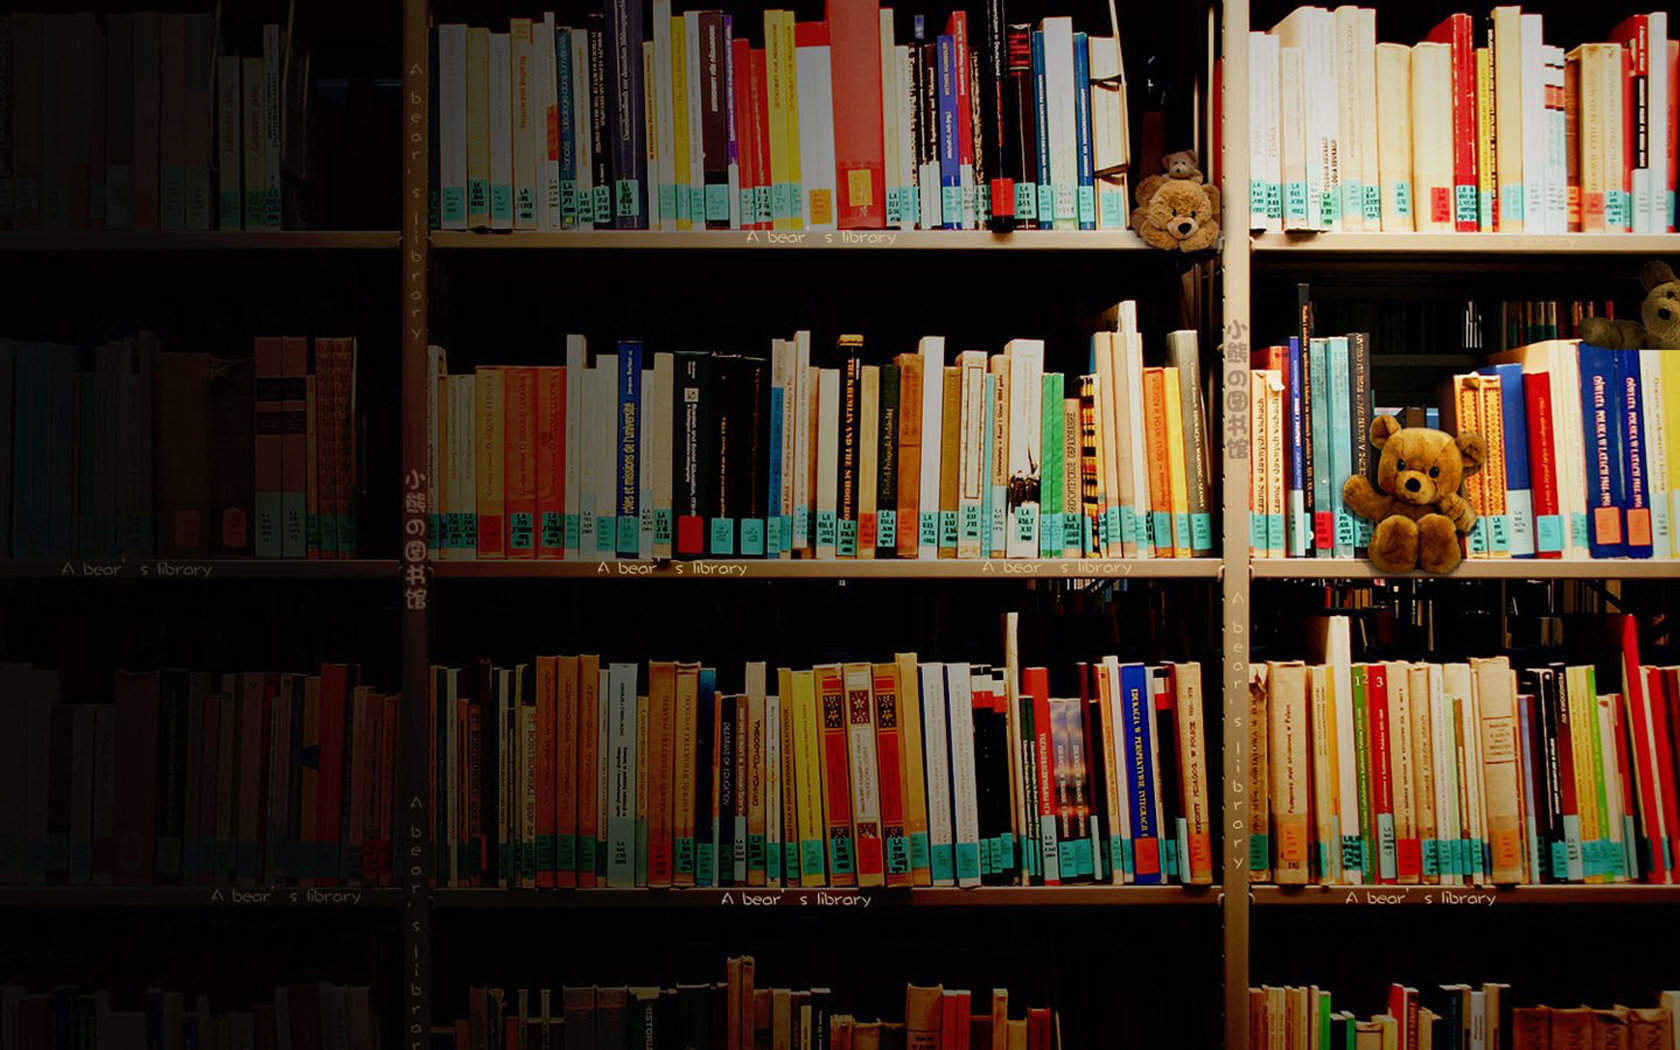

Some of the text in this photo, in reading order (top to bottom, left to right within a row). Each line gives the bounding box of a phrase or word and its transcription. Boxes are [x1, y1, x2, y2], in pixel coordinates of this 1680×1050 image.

[847, 358, 855, 377] THE
[846, 379, 855, 423] KREMLIN
[845, 427, 853, 446] AND
[623, 443, 634, 453] de
[623, 454, 635, 486] missions
[1376, 676, 1384, 688] 3
